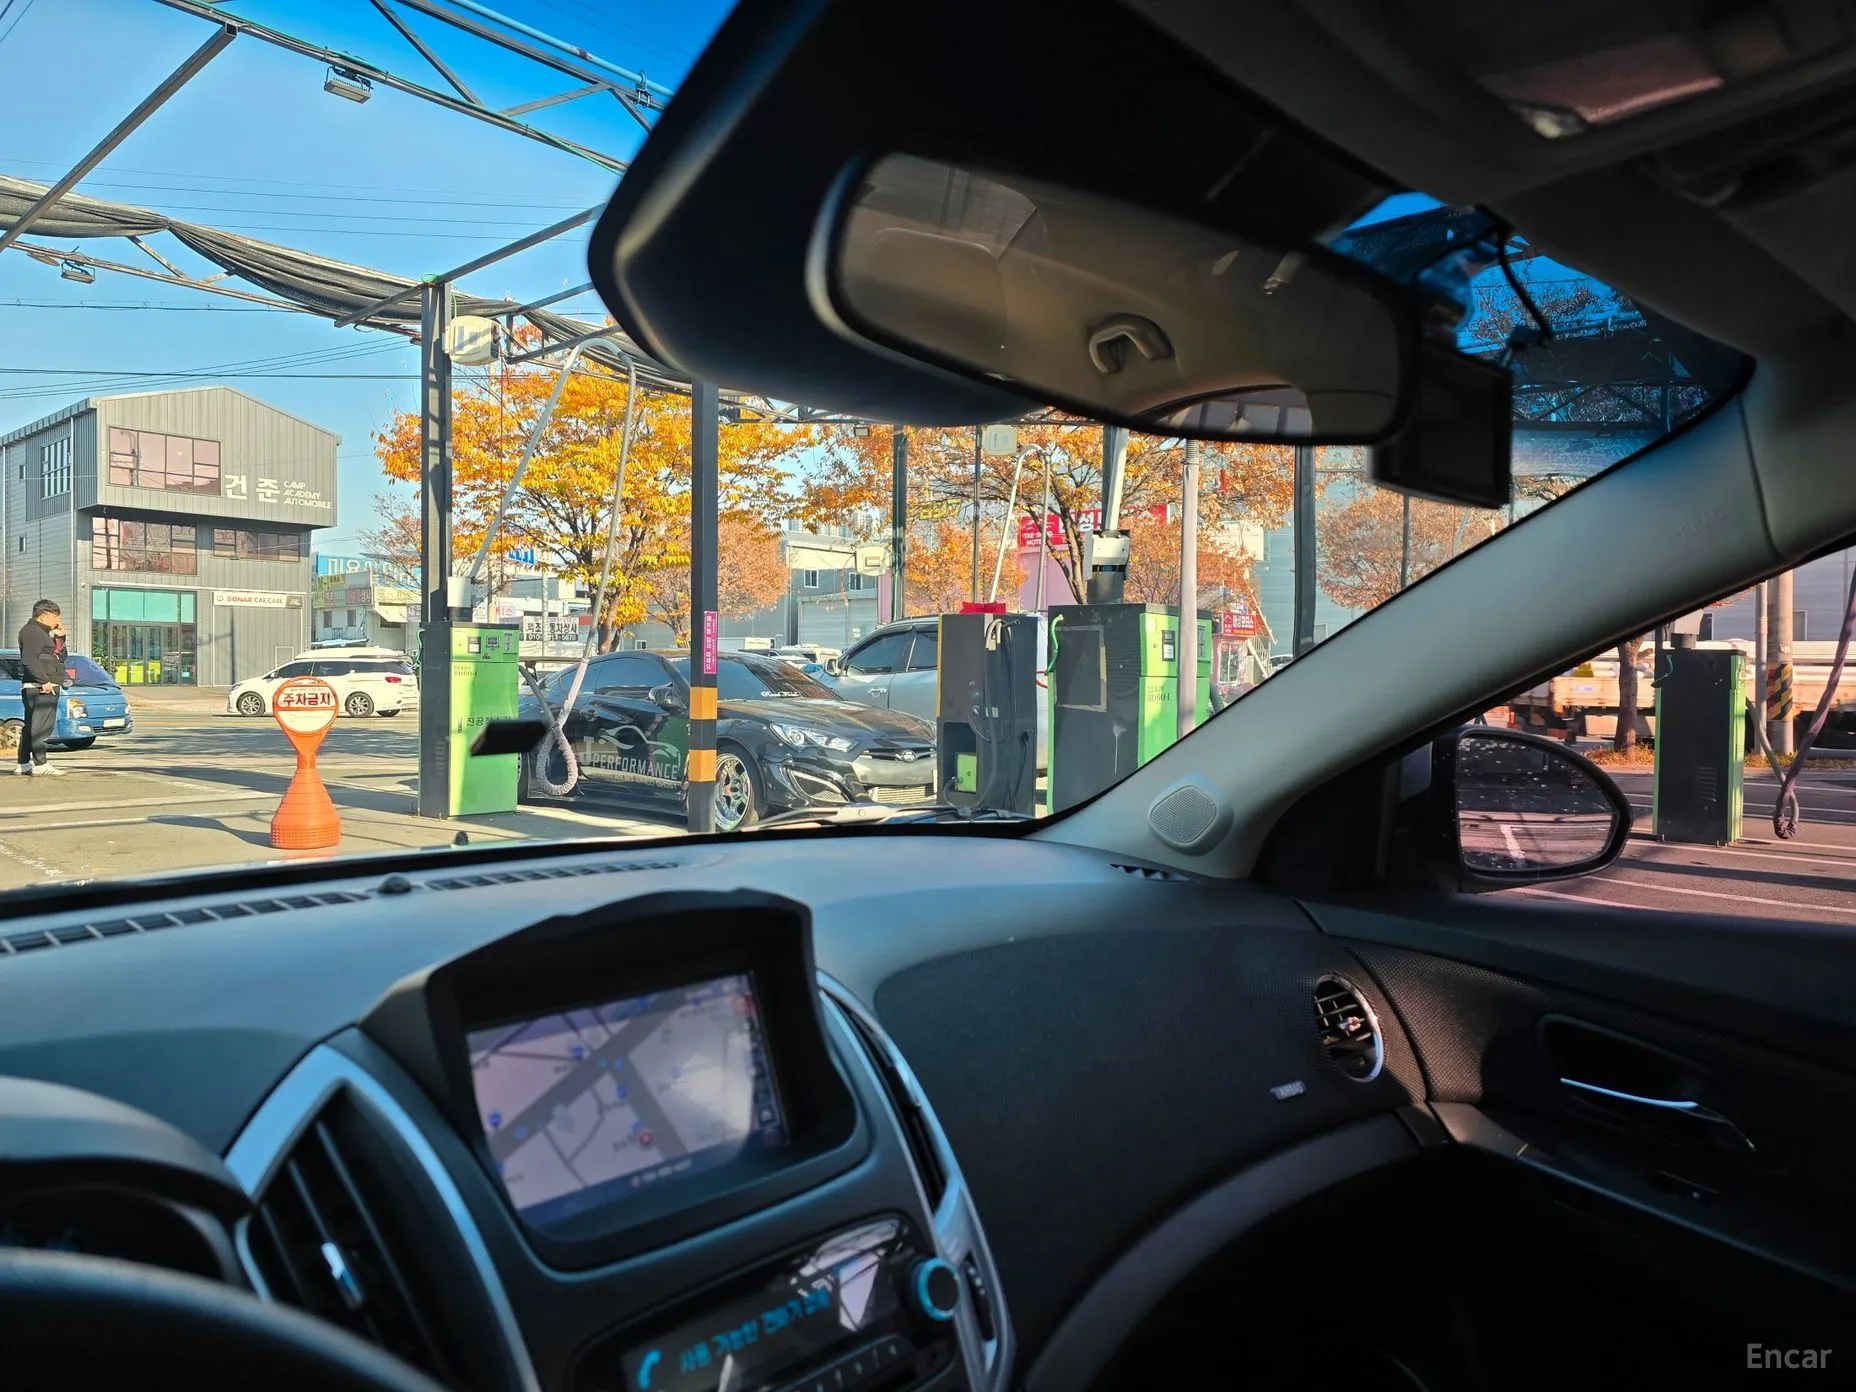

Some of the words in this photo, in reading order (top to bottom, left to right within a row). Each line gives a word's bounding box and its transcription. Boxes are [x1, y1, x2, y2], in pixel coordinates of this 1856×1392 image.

[283, 481, 306, 490] CAMP
[283, 489, 321, 500] ACADEMY
[283, 498, 332, 509] AUTOMOBILE
[227, 595, 253, 604] SONAX
[254, 596, 267, 604] CAR
[283, 692, 331, 706] 주차금지
[592, 754, 679, 780] PERFORMANCE
